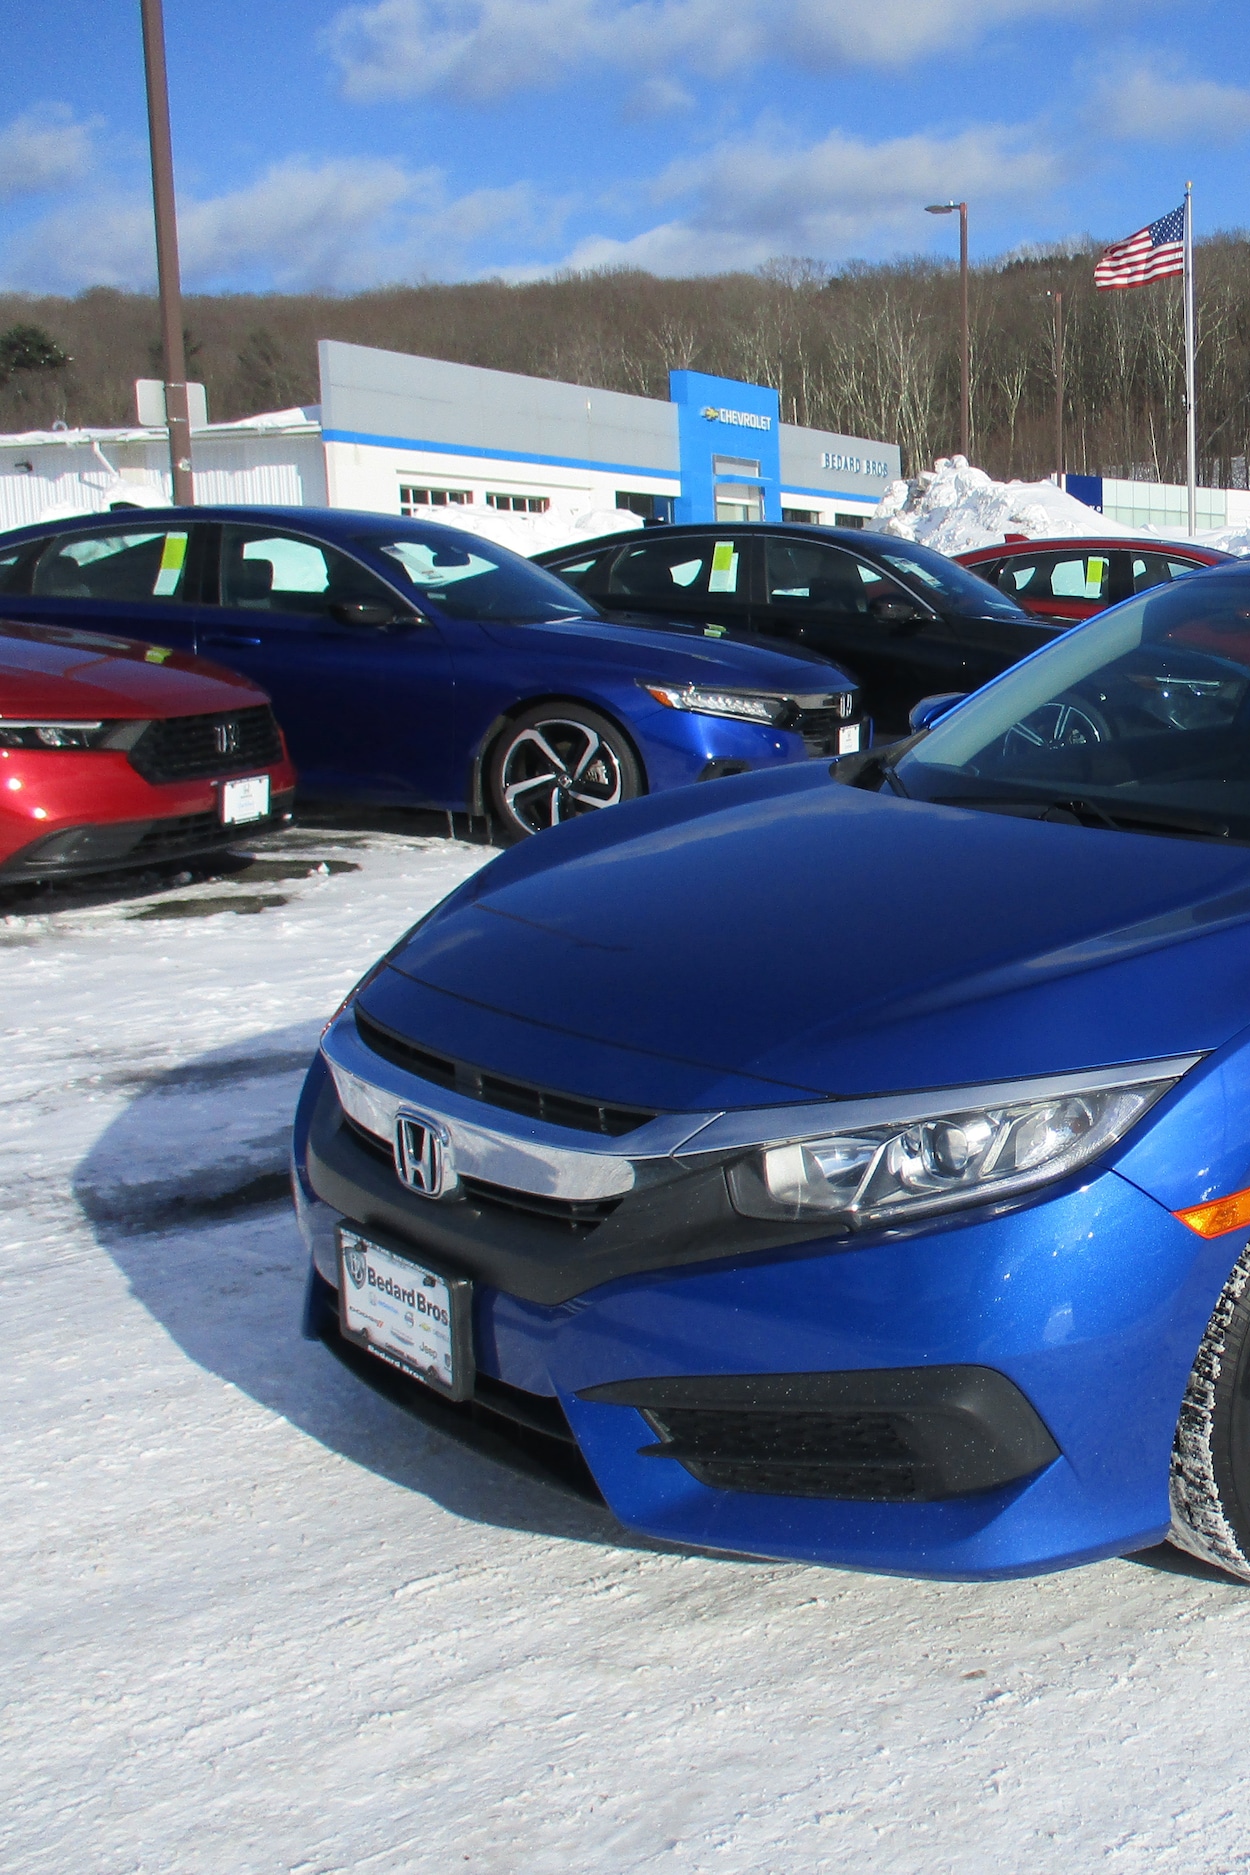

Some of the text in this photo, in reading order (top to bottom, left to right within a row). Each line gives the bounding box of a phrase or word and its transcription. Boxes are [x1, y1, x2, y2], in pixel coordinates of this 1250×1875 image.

[719, 408, 772, 431] CHEVROLET
[822, 452, 889, 478] BEDARD BROS
[367, 1266, 416, 1308] Bedard
[419, 1341, 438, 1359] Jeep
